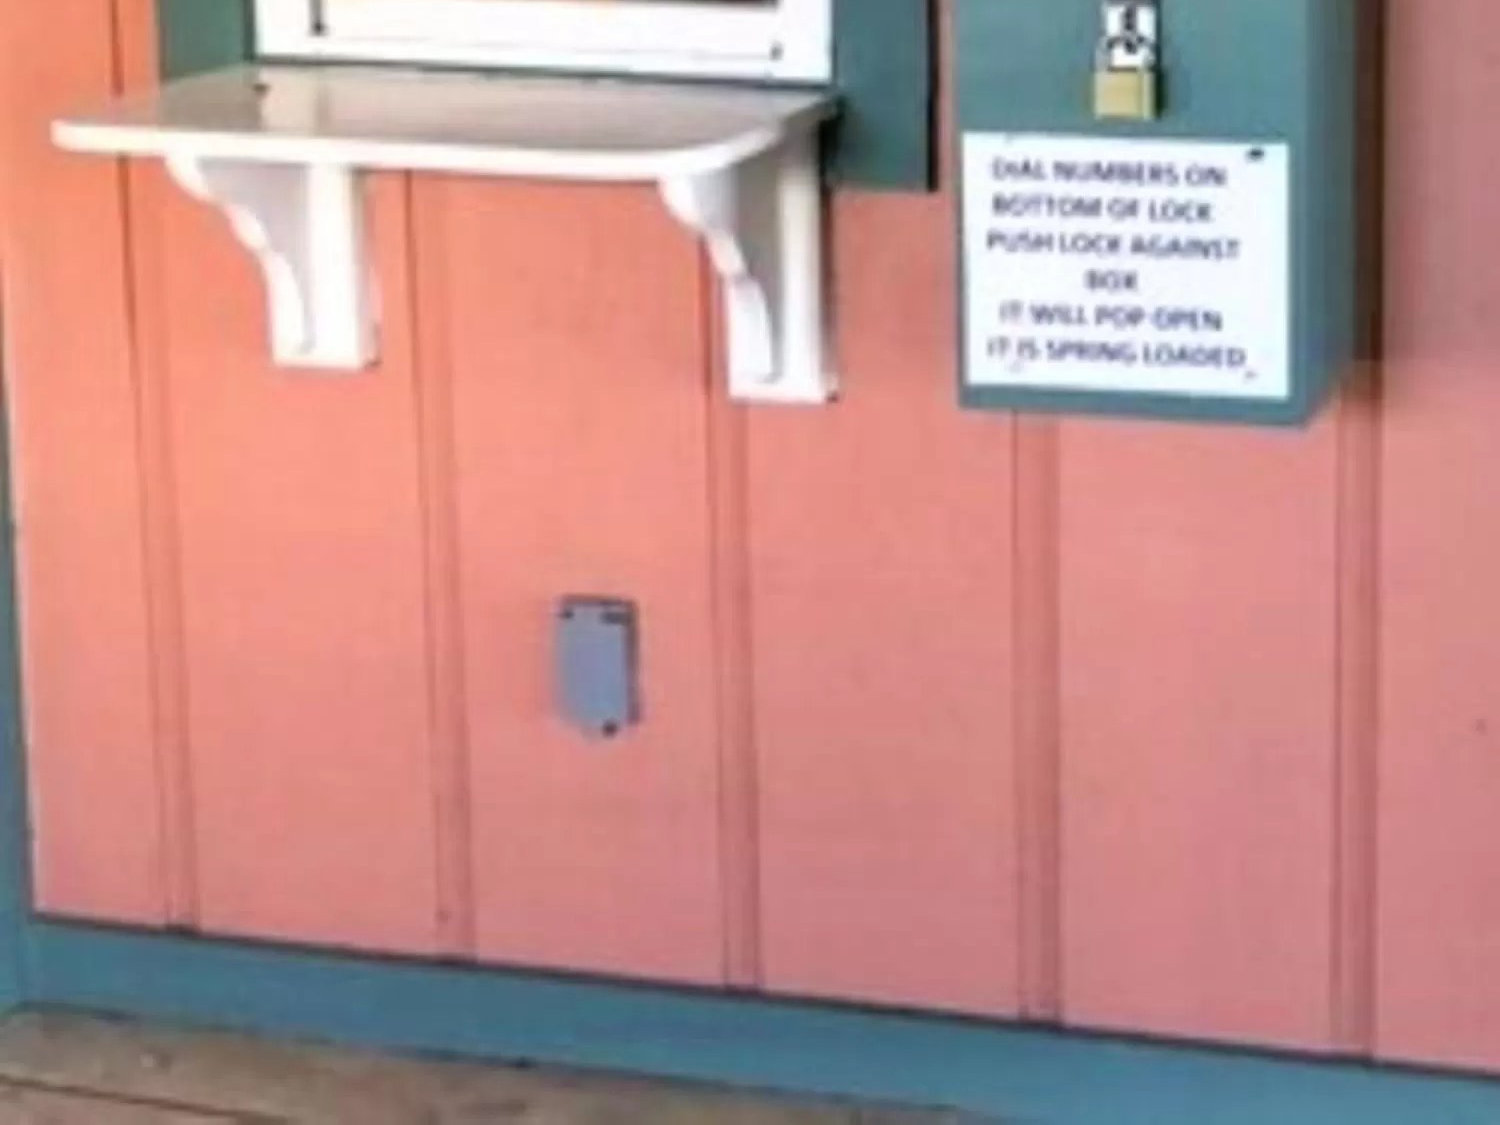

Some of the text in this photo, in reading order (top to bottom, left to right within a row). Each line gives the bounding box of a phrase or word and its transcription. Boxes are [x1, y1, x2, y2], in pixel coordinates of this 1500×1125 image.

[992, 157, 1228, 187] DIAL NUMBERS ON
[992, 193, 1213, 224] BOTTOM OF LOCK
[986, 228, 1240, 260] PUSH LOCK AGAINST
[1084, 269, 1139, 292] BOX
[999, 300, 1223, 332] IT WILL POP OPEN
[987, 336, 1247, 368] IT IS SPRING LOADED
